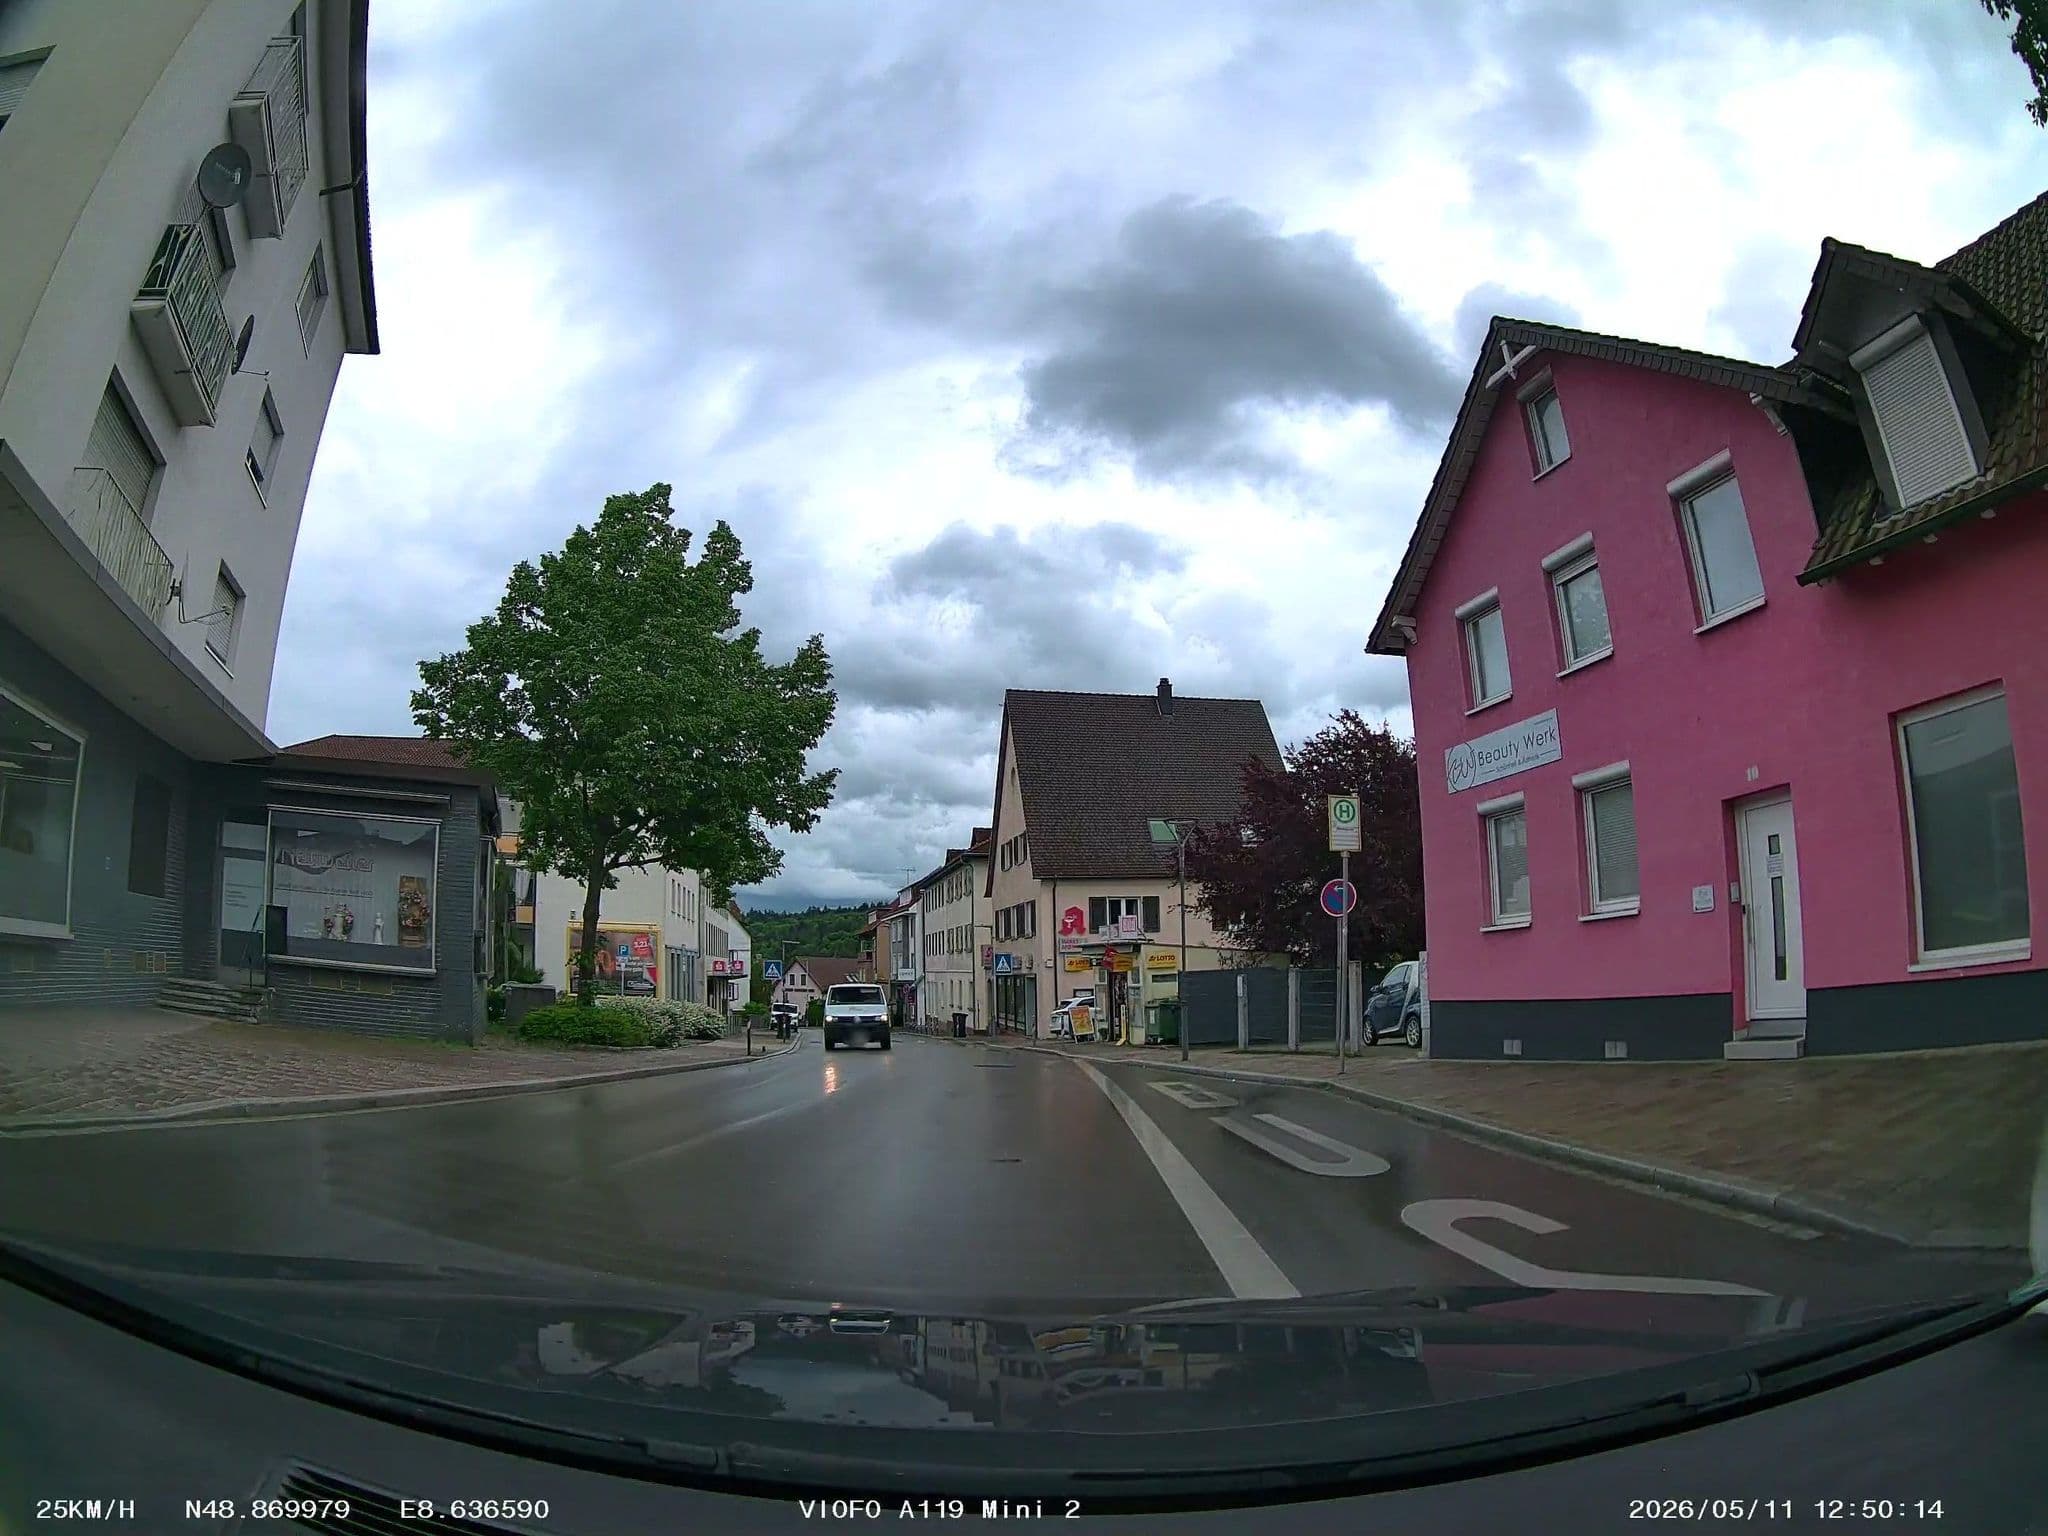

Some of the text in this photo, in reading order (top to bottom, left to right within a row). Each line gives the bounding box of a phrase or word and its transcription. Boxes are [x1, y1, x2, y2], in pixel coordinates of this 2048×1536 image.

[1477, 741, 1520, 767] Beauty
[1522, 726, 1557, 749] Werk
[1339, 805, 1350, 818] H
[620, 946, 627, 955] P
